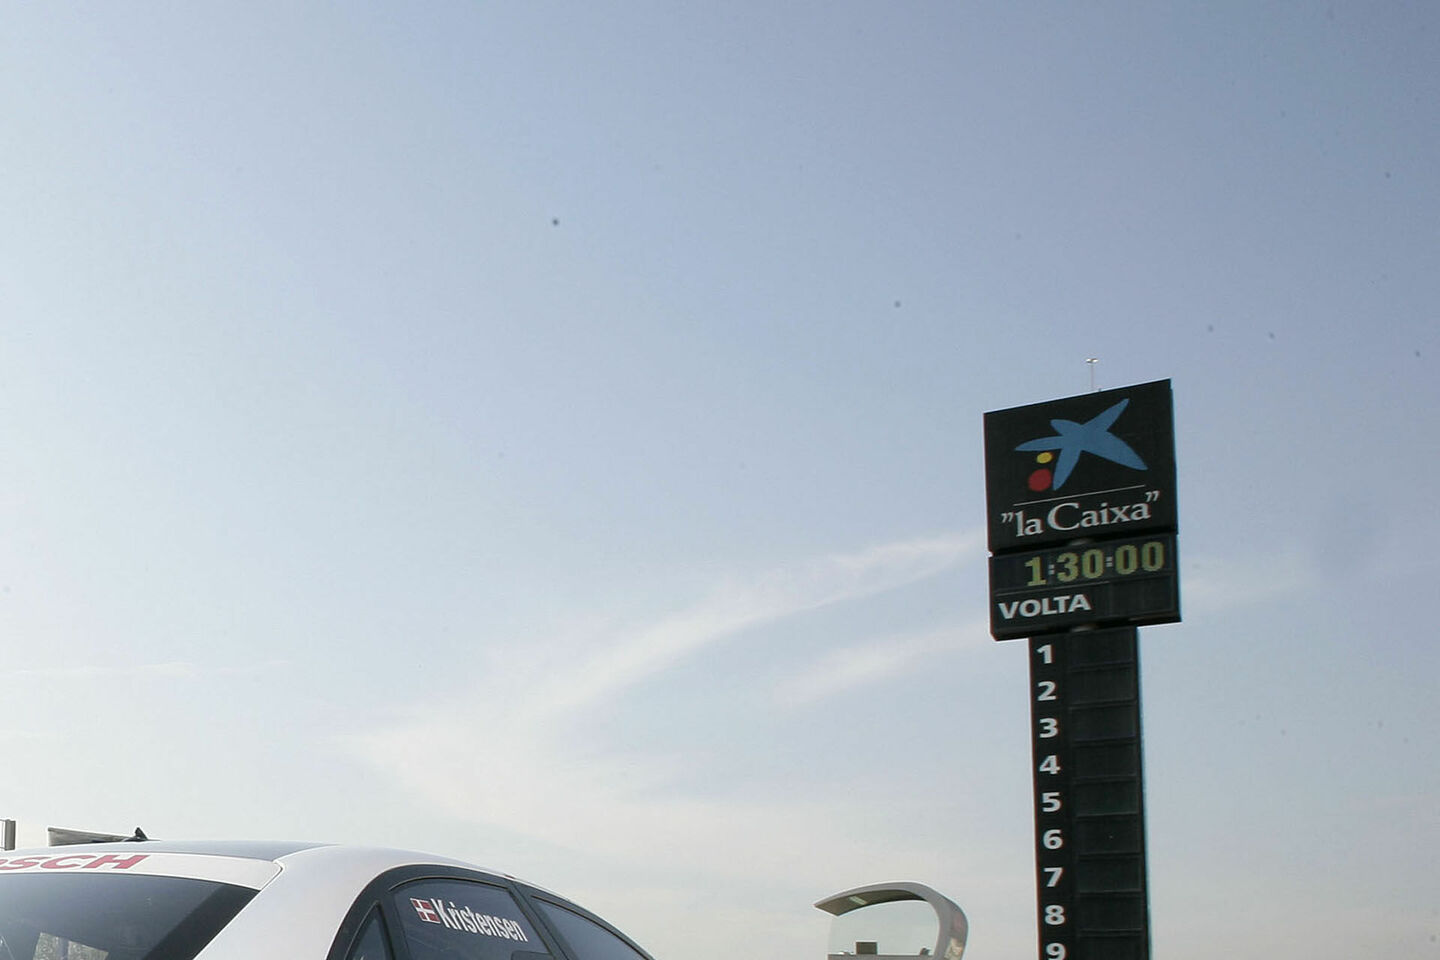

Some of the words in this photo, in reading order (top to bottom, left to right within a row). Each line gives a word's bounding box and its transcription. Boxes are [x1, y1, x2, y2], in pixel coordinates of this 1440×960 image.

[1024, 541, 1165, 587] 1:30:00
[998, 594, 1092, 620] VOLTA
[1037, 644, 1052, 664] 1
[1037, 681, 1056, 701] 2
[1039, 717, 1058, 738] 3
[1039, 755, 1060, 775] 4
[1041, 792, 1061, 812] 5
[1043, 829, 1063, 850] 6
[1044, 867, 1063, 887] 7
[431, 898, 528, 943] Kristensen
[1044, 904, 1065, 925] 8
